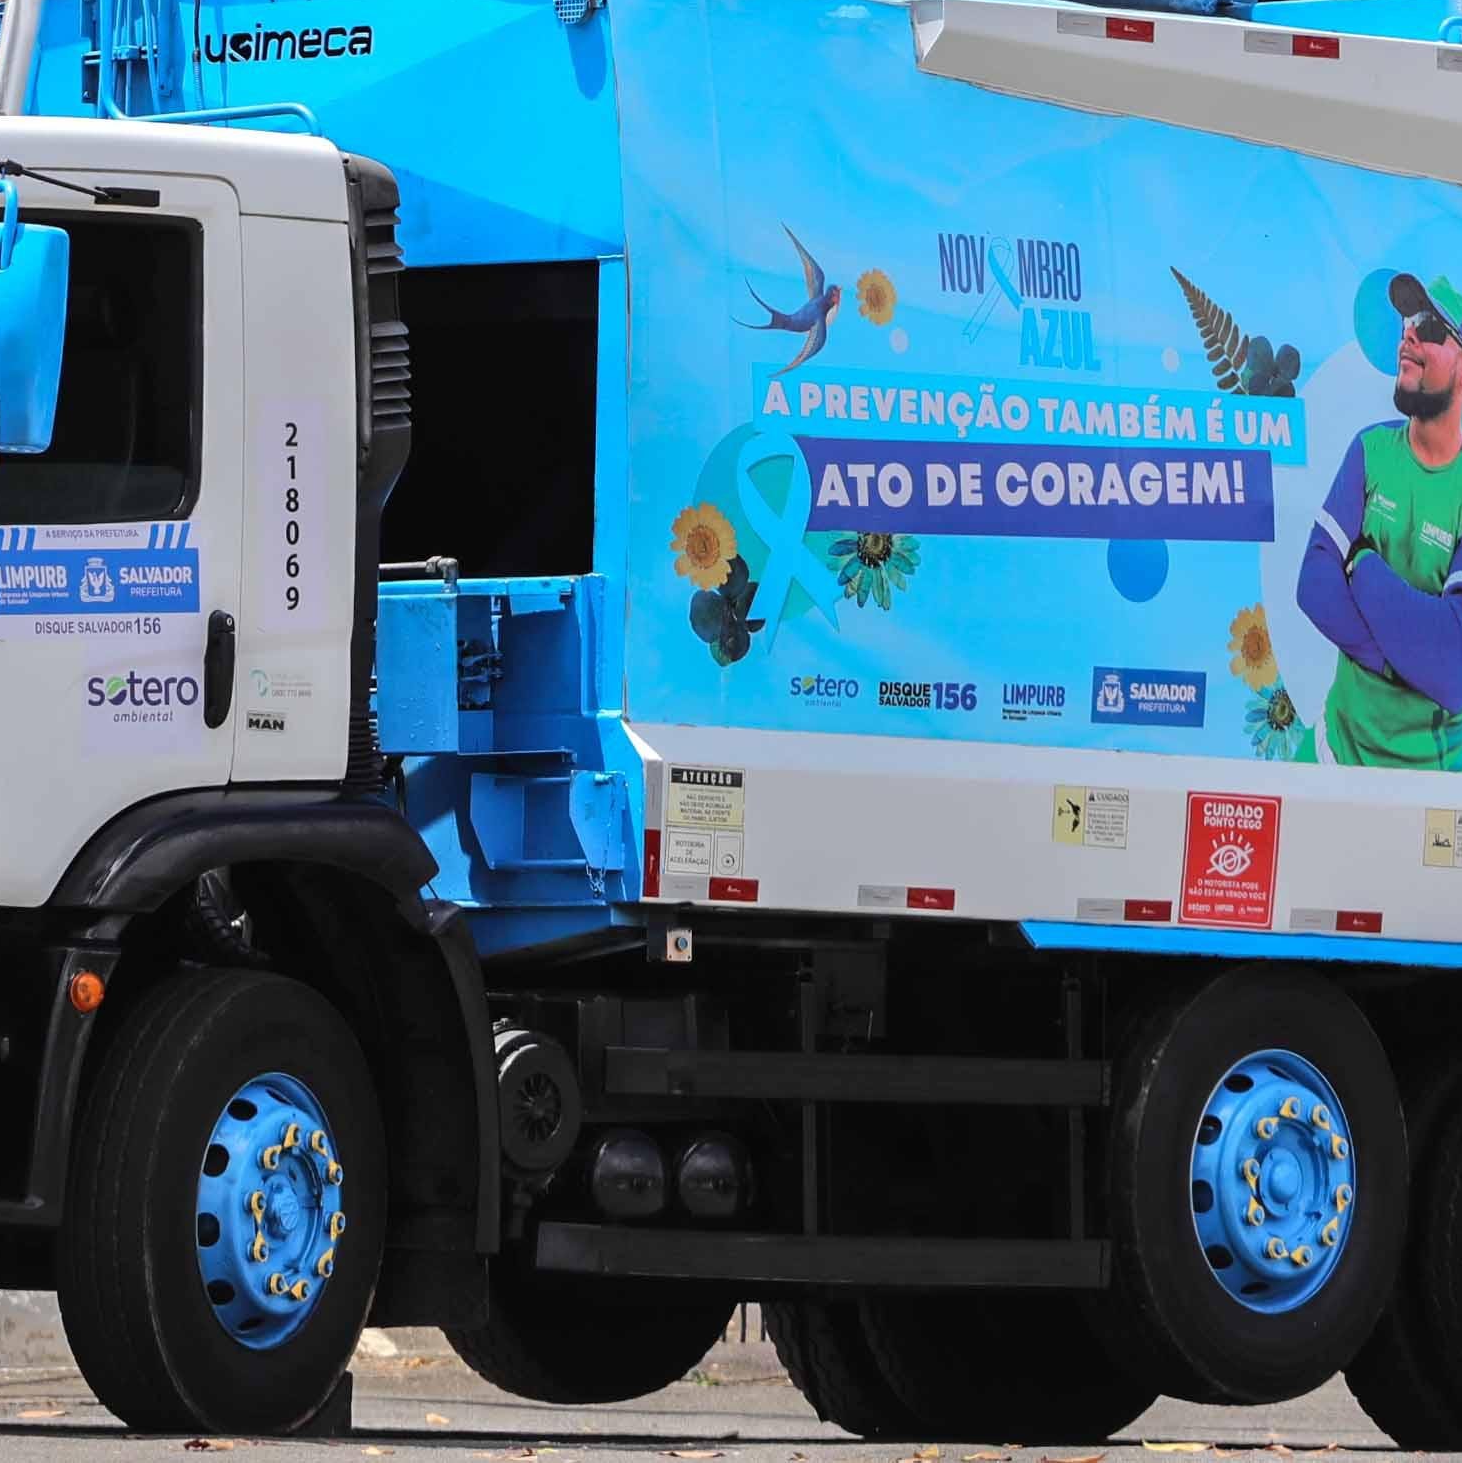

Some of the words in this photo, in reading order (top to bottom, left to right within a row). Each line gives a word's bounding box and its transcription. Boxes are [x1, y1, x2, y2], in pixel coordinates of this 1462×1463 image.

[204, 22, 373, 64] usimeca
[1018, 307, 1102, 372] AZUL
[762, 380, 791, 416] A
[800, 381, 1030, 439] PREVENÇÃO
[1037, 394, 1197, 442] TAMBÉM
[1206, 397, 1225, 443] É
[1234, 409, 1293, 447] UM
[816, 461, 913, 508] ATO
[925, 462, 984, 507] DE
[995, 459, 1246, 507] CORAGEM!
[119, 565, 193, 585] SALVADOR
[130, 587, 183, 597] PREFEITURA
[35, 621, 74, 635] DISQUE
[78, 620, 133, 635] SALVADOR
[134, 617, 162, 635] 156
[88, 670, 199, 707] sotero
[790, 673, 859, 699] sotero
[879, 681, 931, 697] DISQUE
[932, 681, 978, 711] 156
[1002, 683, 1066, 707] LIMPURB
[1129, 682, 1197, 703] SALVADOR
[878, 696, 931, 709] SALVADOR
[1138, 702, 1187, 714] PREFEITURA
[113, 710, 174, 723] ambiental
[248, 718, 285, 731] MAN
[1203, 801, 1264, 819] CUIDADO
[1203, 816, 1235, 828] PONTO
[1237, 817, 1262, 830] CEGO
